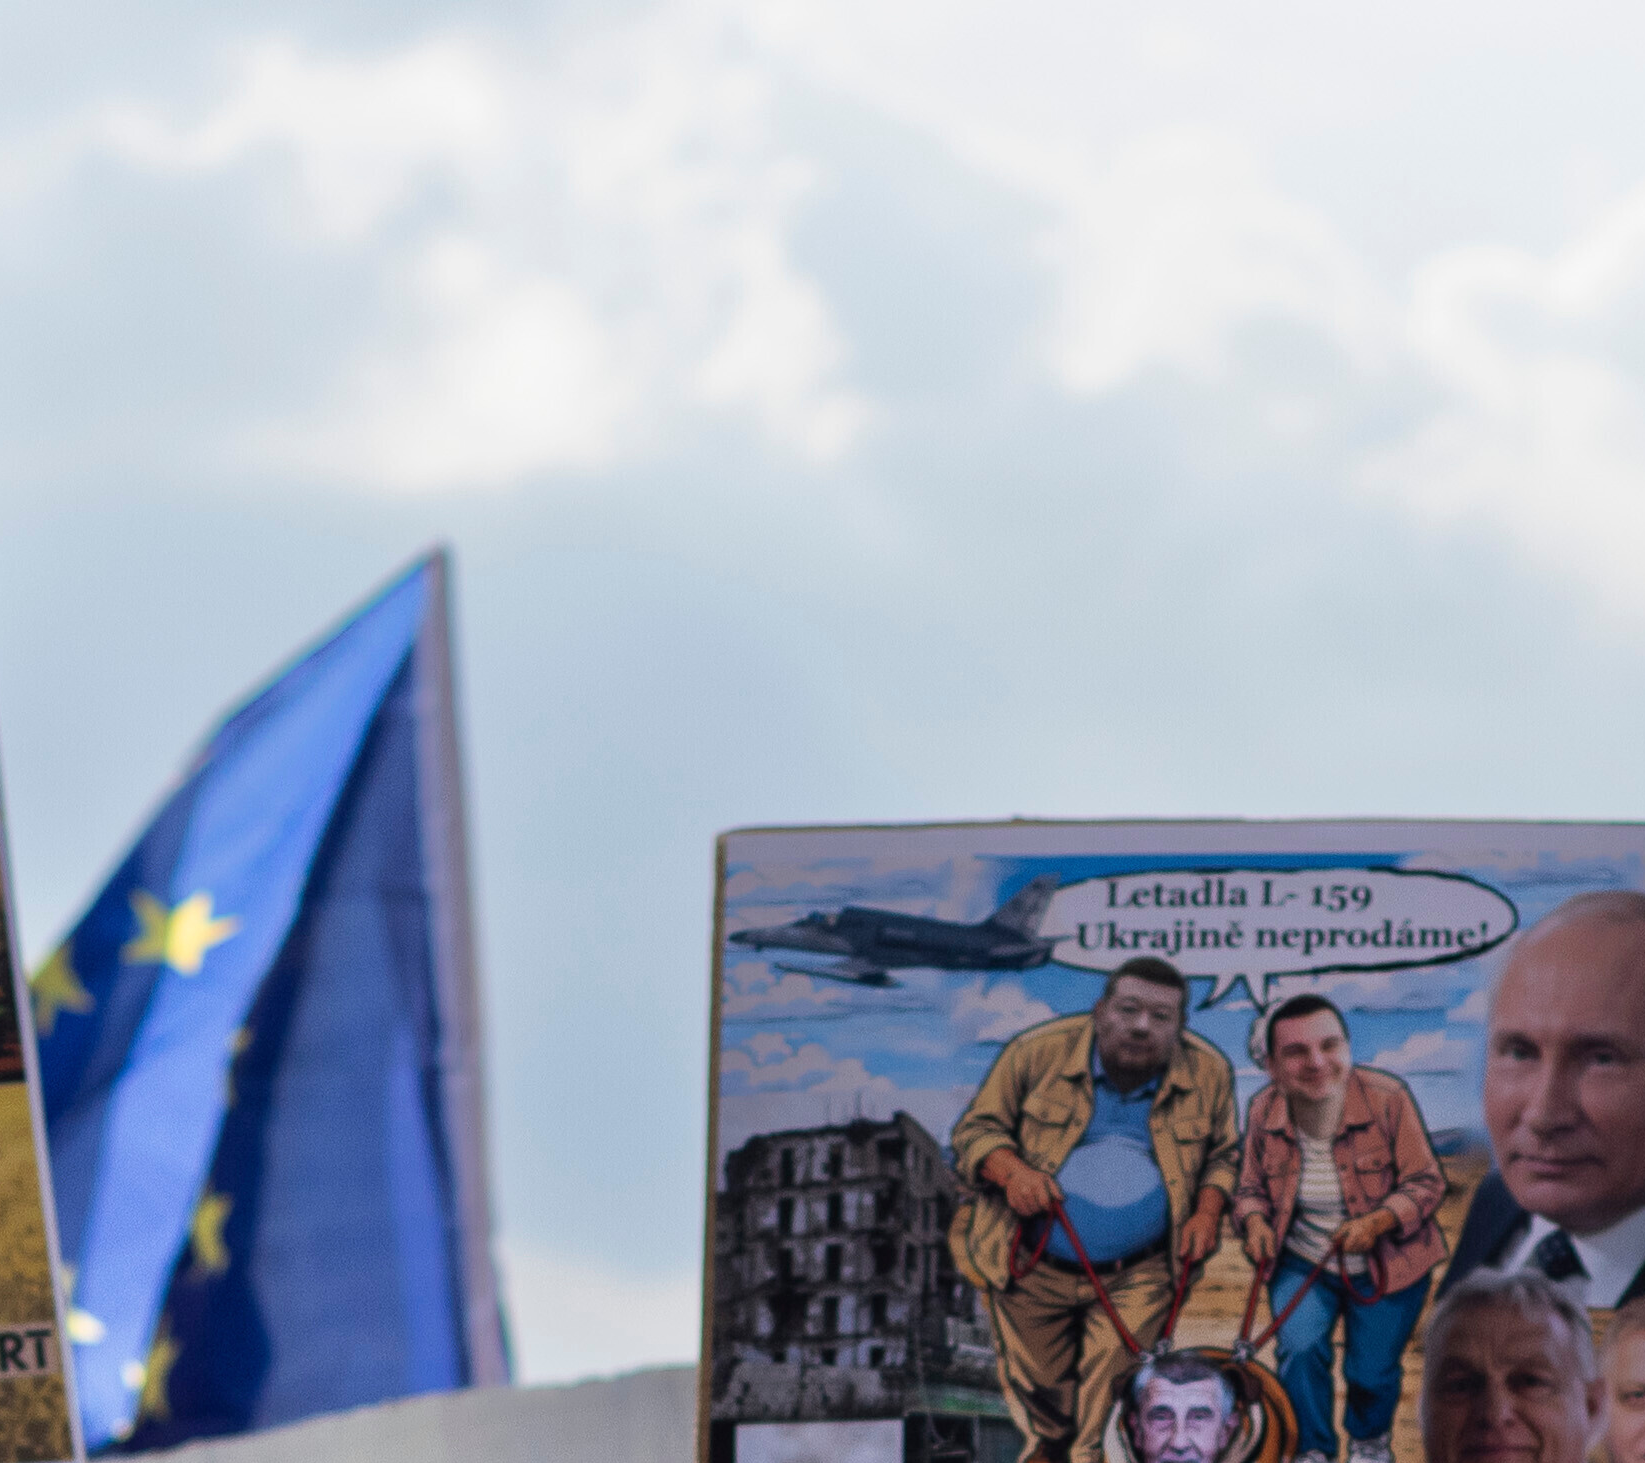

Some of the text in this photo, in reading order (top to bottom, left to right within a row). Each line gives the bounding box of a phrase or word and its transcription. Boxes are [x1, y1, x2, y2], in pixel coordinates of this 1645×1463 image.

[1106, 878, 1248, 909] Letadla
[1310, 878, 1373, 912] 159
[1075, 918, 1492, 956] Ukrajině neprodáme!
